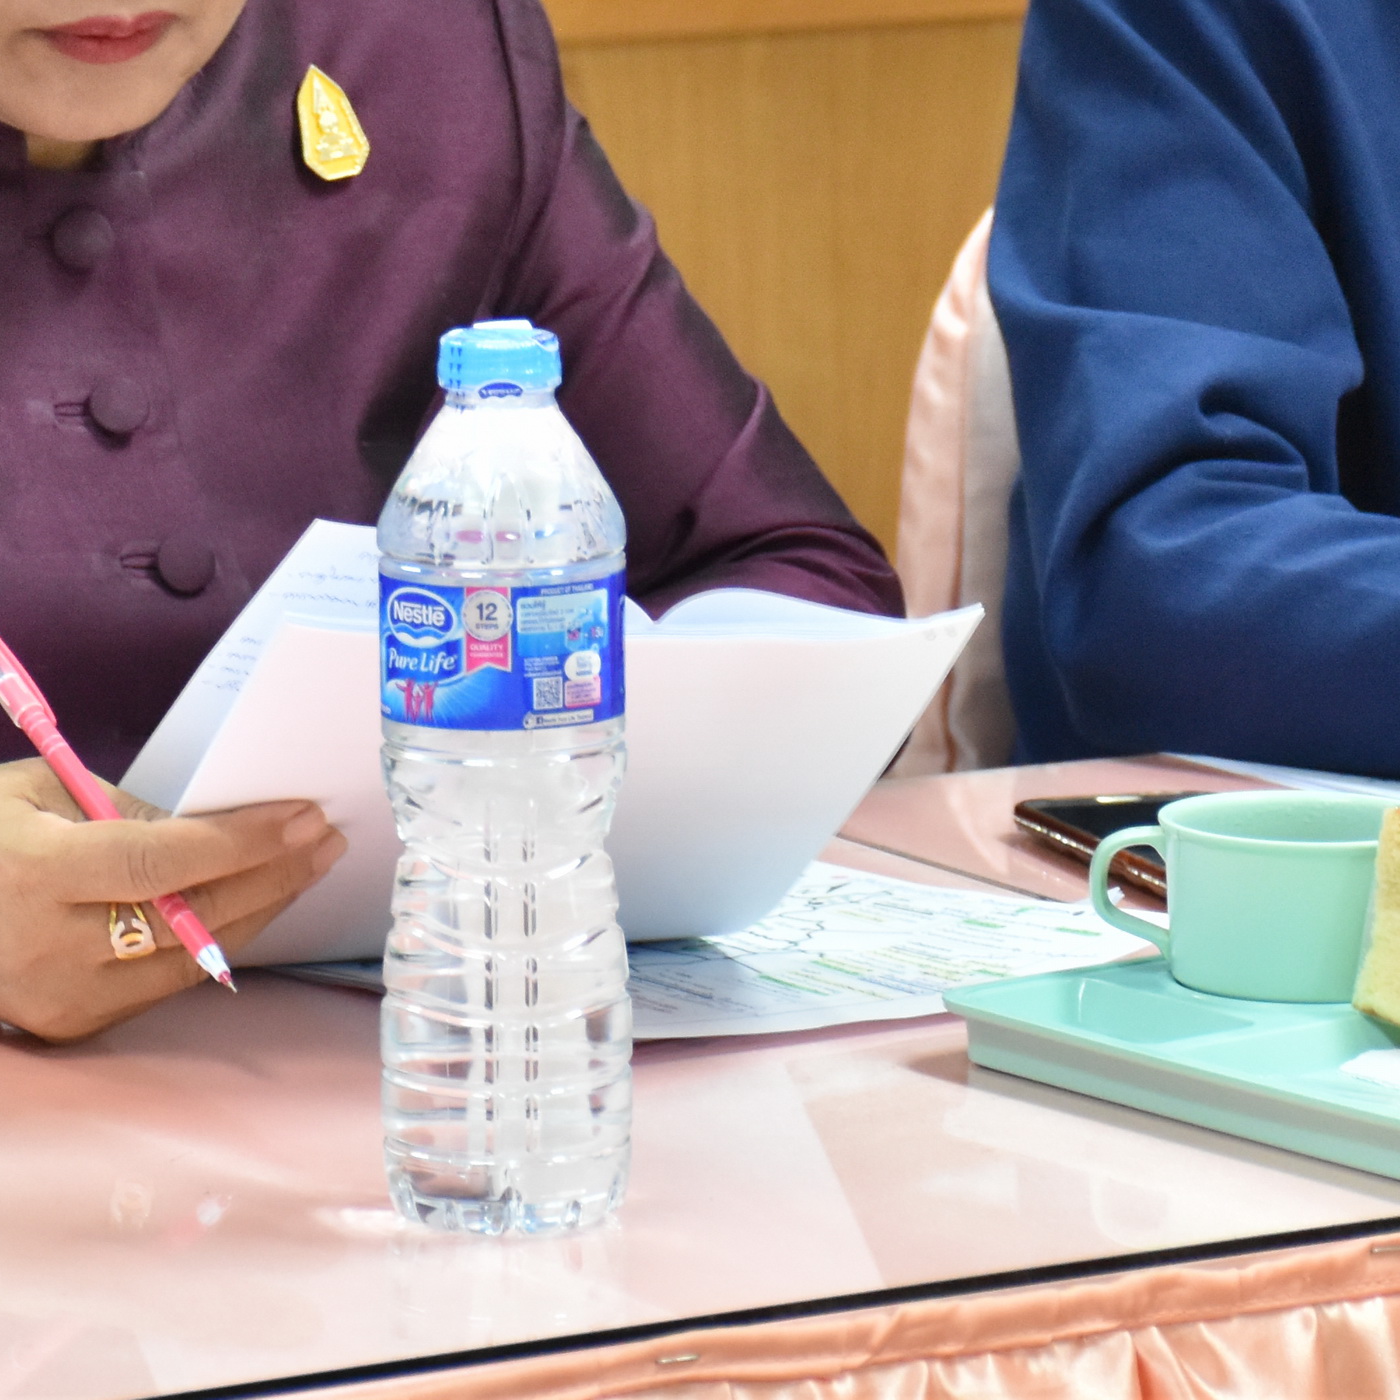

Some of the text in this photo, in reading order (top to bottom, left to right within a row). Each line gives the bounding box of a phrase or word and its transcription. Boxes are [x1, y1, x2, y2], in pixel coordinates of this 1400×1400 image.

[476, 602, 498, 621] 12
[388, 647, 456, 674] Pure Life
